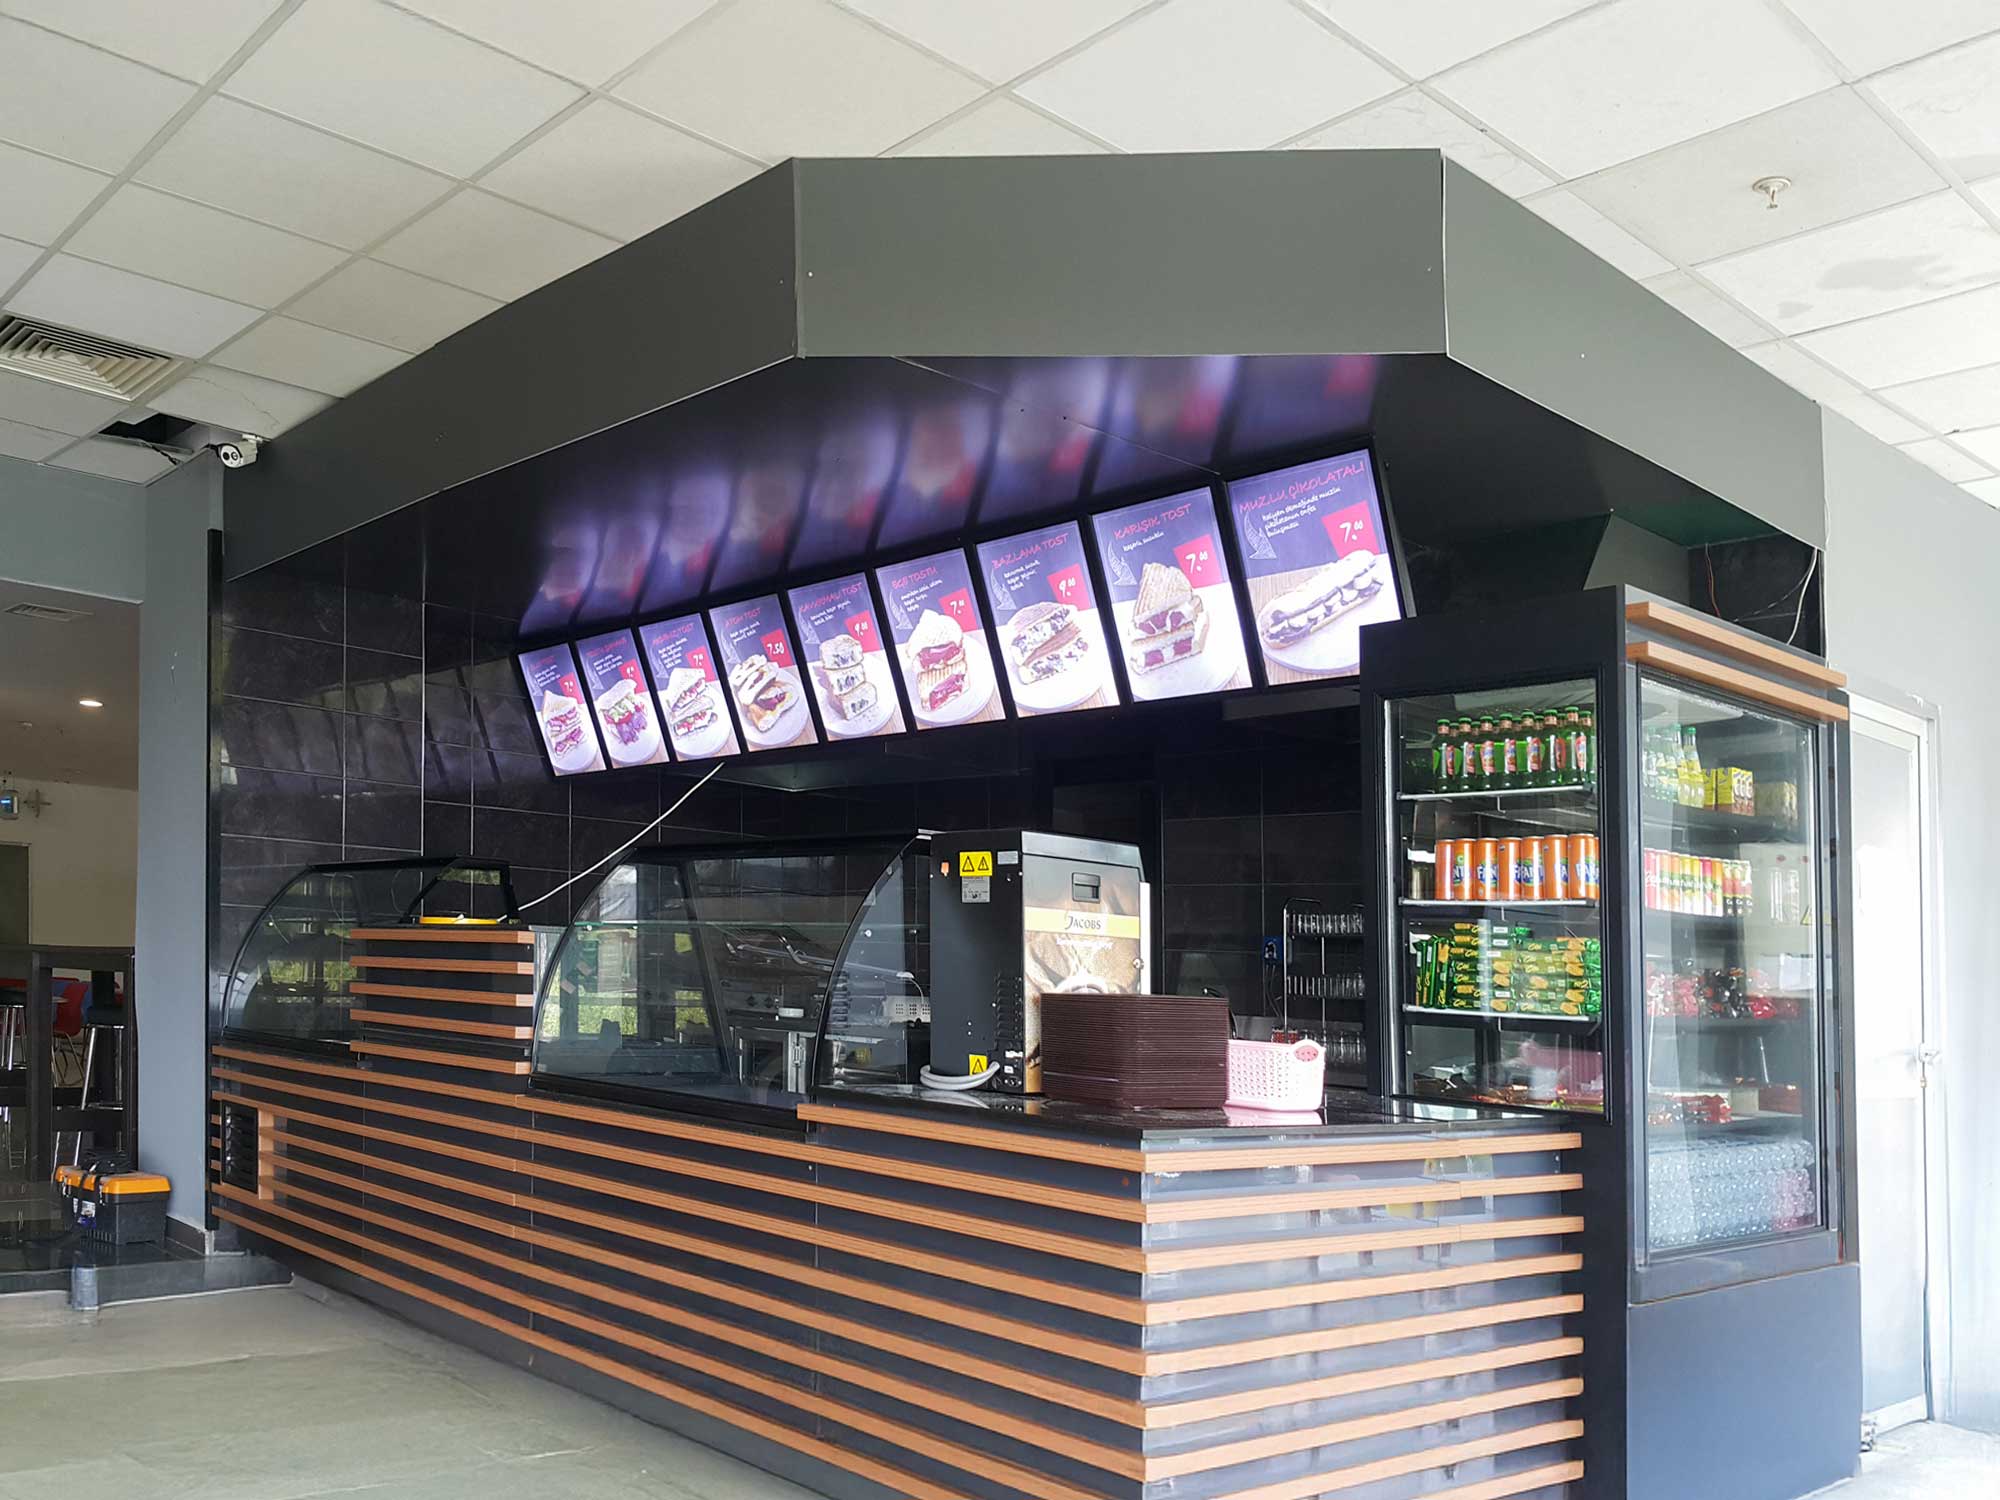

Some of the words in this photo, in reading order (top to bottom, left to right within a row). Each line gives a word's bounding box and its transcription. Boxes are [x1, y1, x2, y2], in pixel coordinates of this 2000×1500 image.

[1161, 503, 1192, 521] TOST
[1041, 532, 1069, 550] TOST
[841, 582, 862, 597] TOST
[1064, 915, 1102, 931] JACOBS
